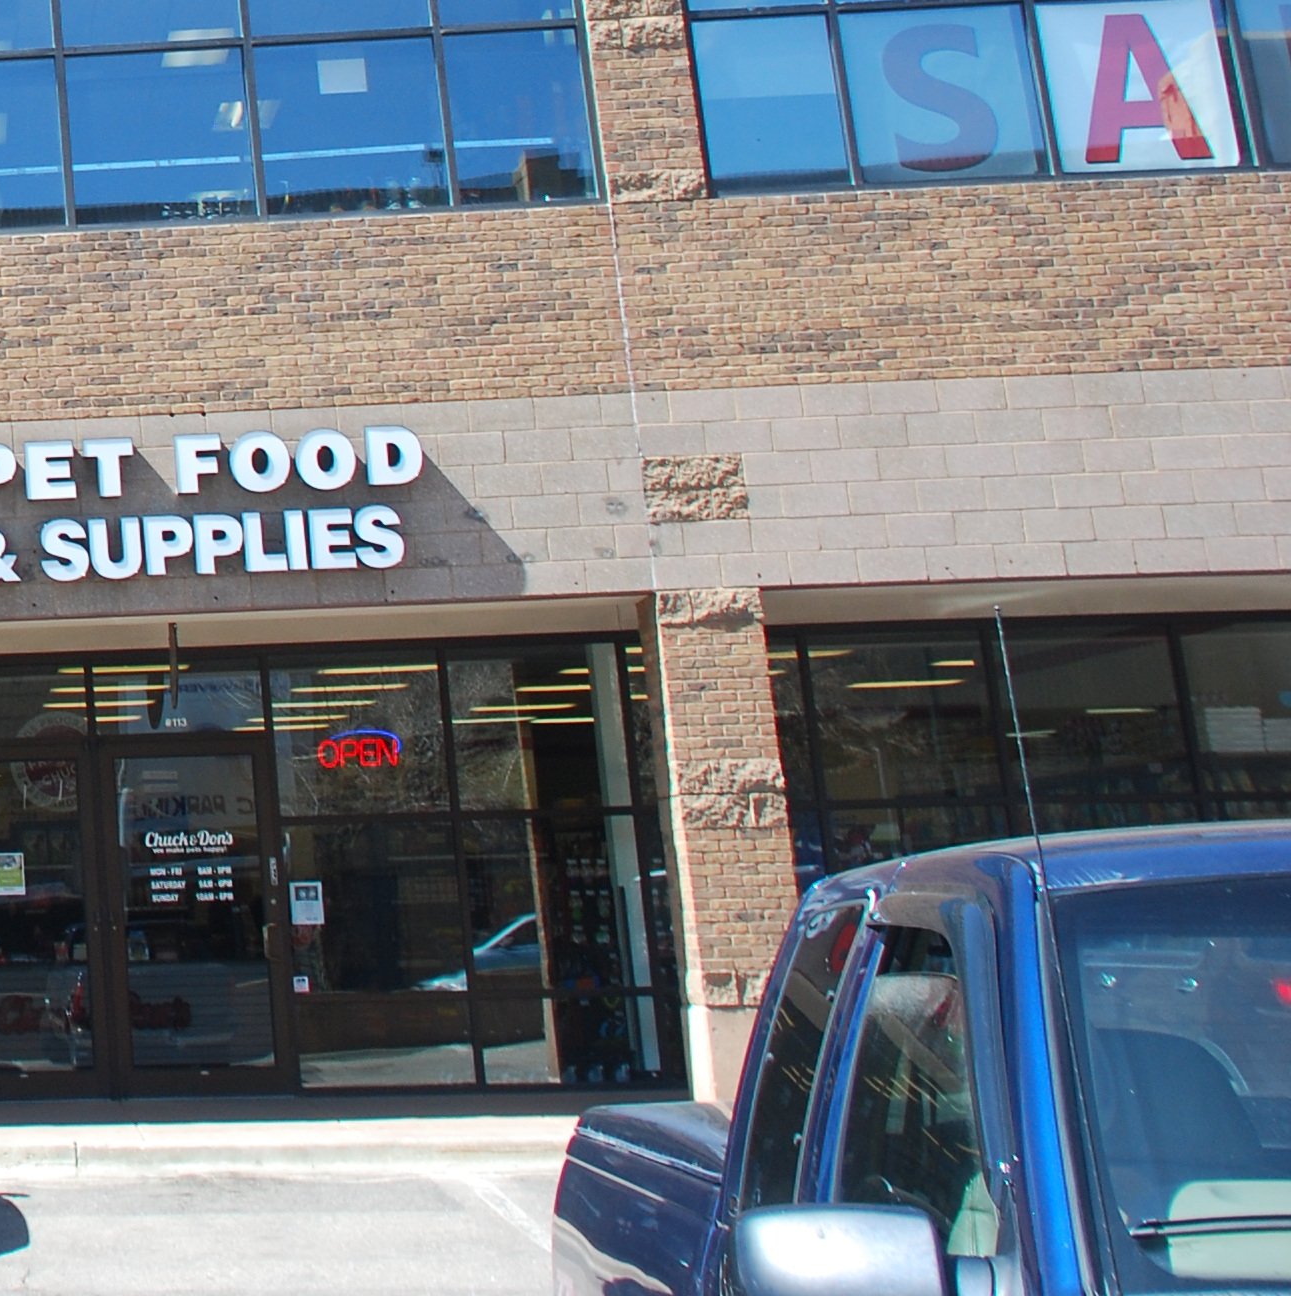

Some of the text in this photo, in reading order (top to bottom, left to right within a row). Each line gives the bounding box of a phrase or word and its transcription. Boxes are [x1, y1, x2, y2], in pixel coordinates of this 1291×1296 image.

[881, 3, 1291, 173] SA
[174, 425, 424, 495] FOOD
[40, 504, 406, 583] SUPPLIES
[317, 737, 399, 769] OPEN
[145, 831, 189, 848] Chuck
[197, 830, 234, 846] Don's
[151, 880, 186, 889] SATURDAY
[152, 893, 179, 902] SUNDAY
